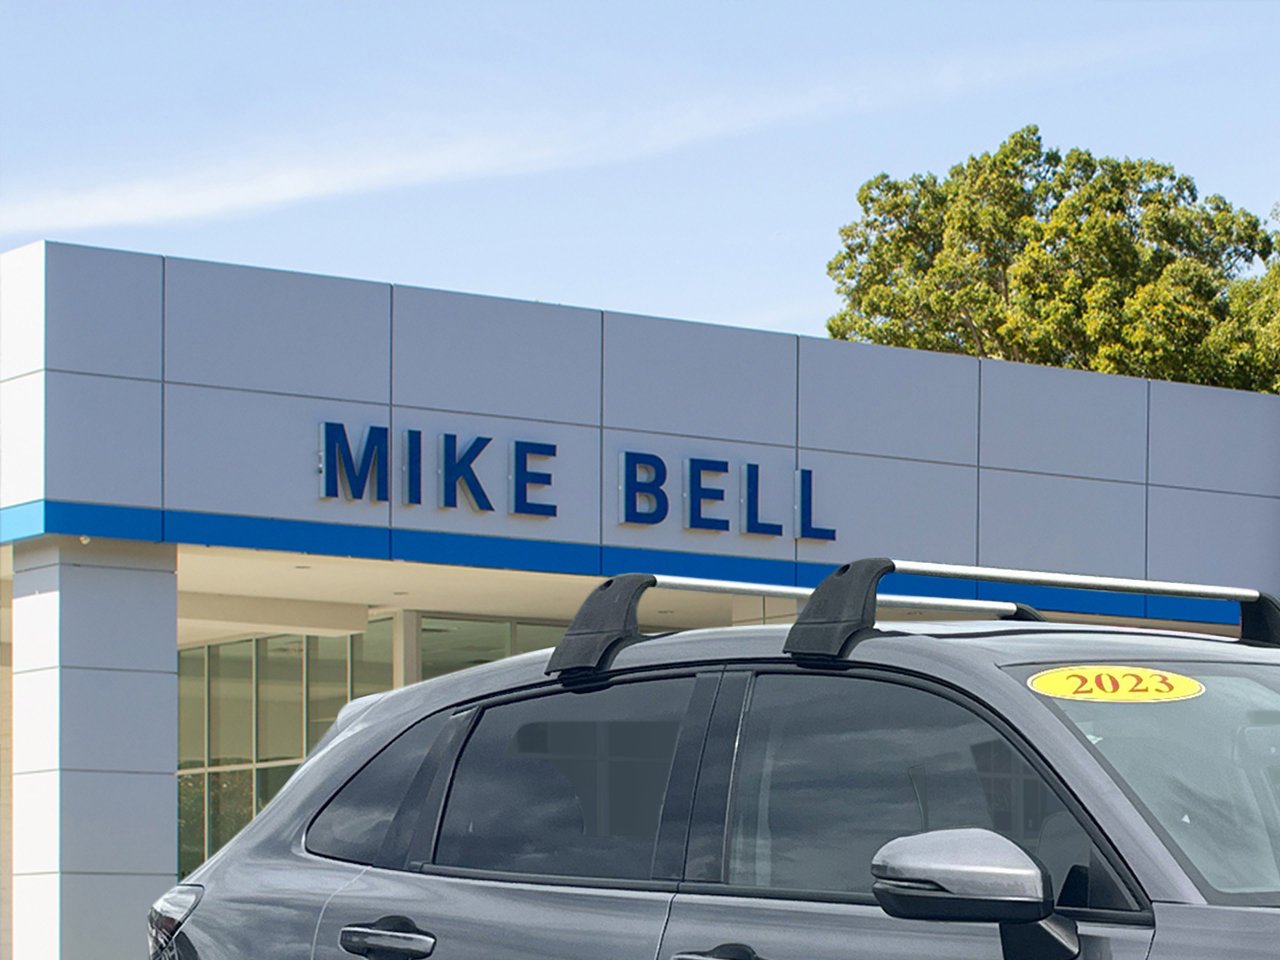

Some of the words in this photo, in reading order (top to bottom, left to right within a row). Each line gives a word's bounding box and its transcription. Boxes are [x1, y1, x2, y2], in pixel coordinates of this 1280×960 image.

[320, 421, 558, 518] MIKE
[617, 450, 837, 542] BELL
[1066, 672, 1175, 695] 2023
